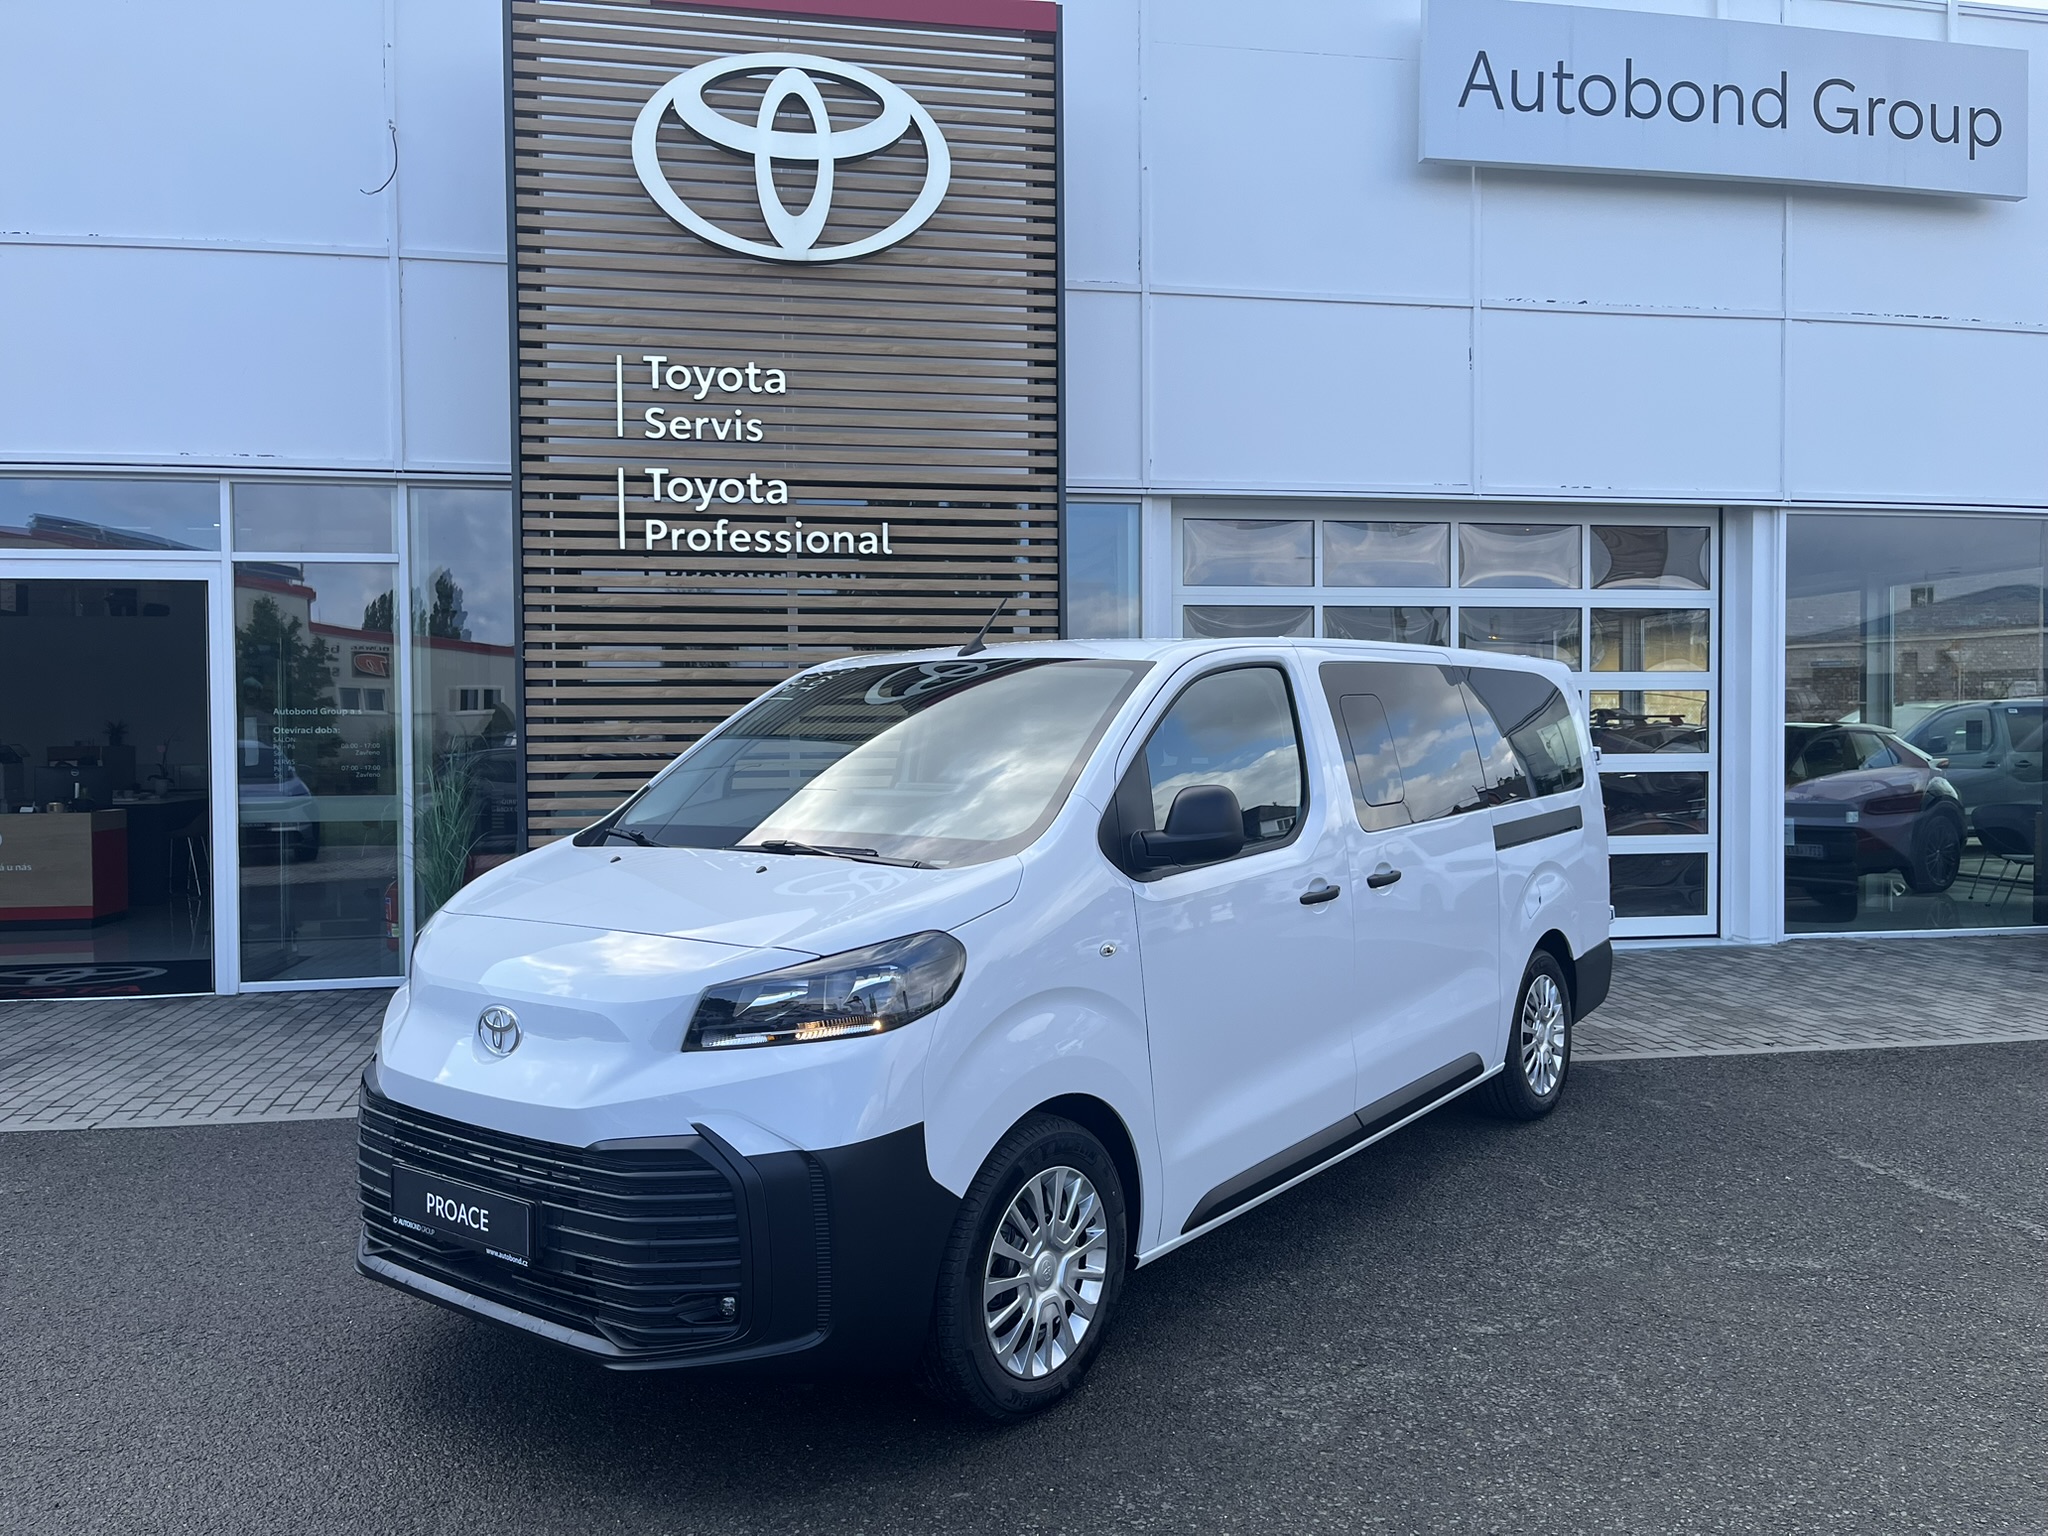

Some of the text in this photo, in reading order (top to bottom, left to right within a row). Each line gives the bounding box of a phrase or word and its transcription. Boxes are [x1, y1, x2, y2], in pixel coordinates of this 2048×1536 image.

[1458, 49, 2003, 160] Autobond Group
[642, 355, 787, 400] Toyota
[644, 407, 764, 442] Servis
[644, 468, 789, 511] Toyota
[645, 519, 893, 555] Professional
[273, 707, 318, 715] Autobond
[320, 708, 348, 716] Group
[273, 726, 313, 734] Otevírací
[15, 863, 32, 871] nás
[426, 1192, 489, 1232] PROACE
[485, 1248, 528, 1266] www.autobond.cz
